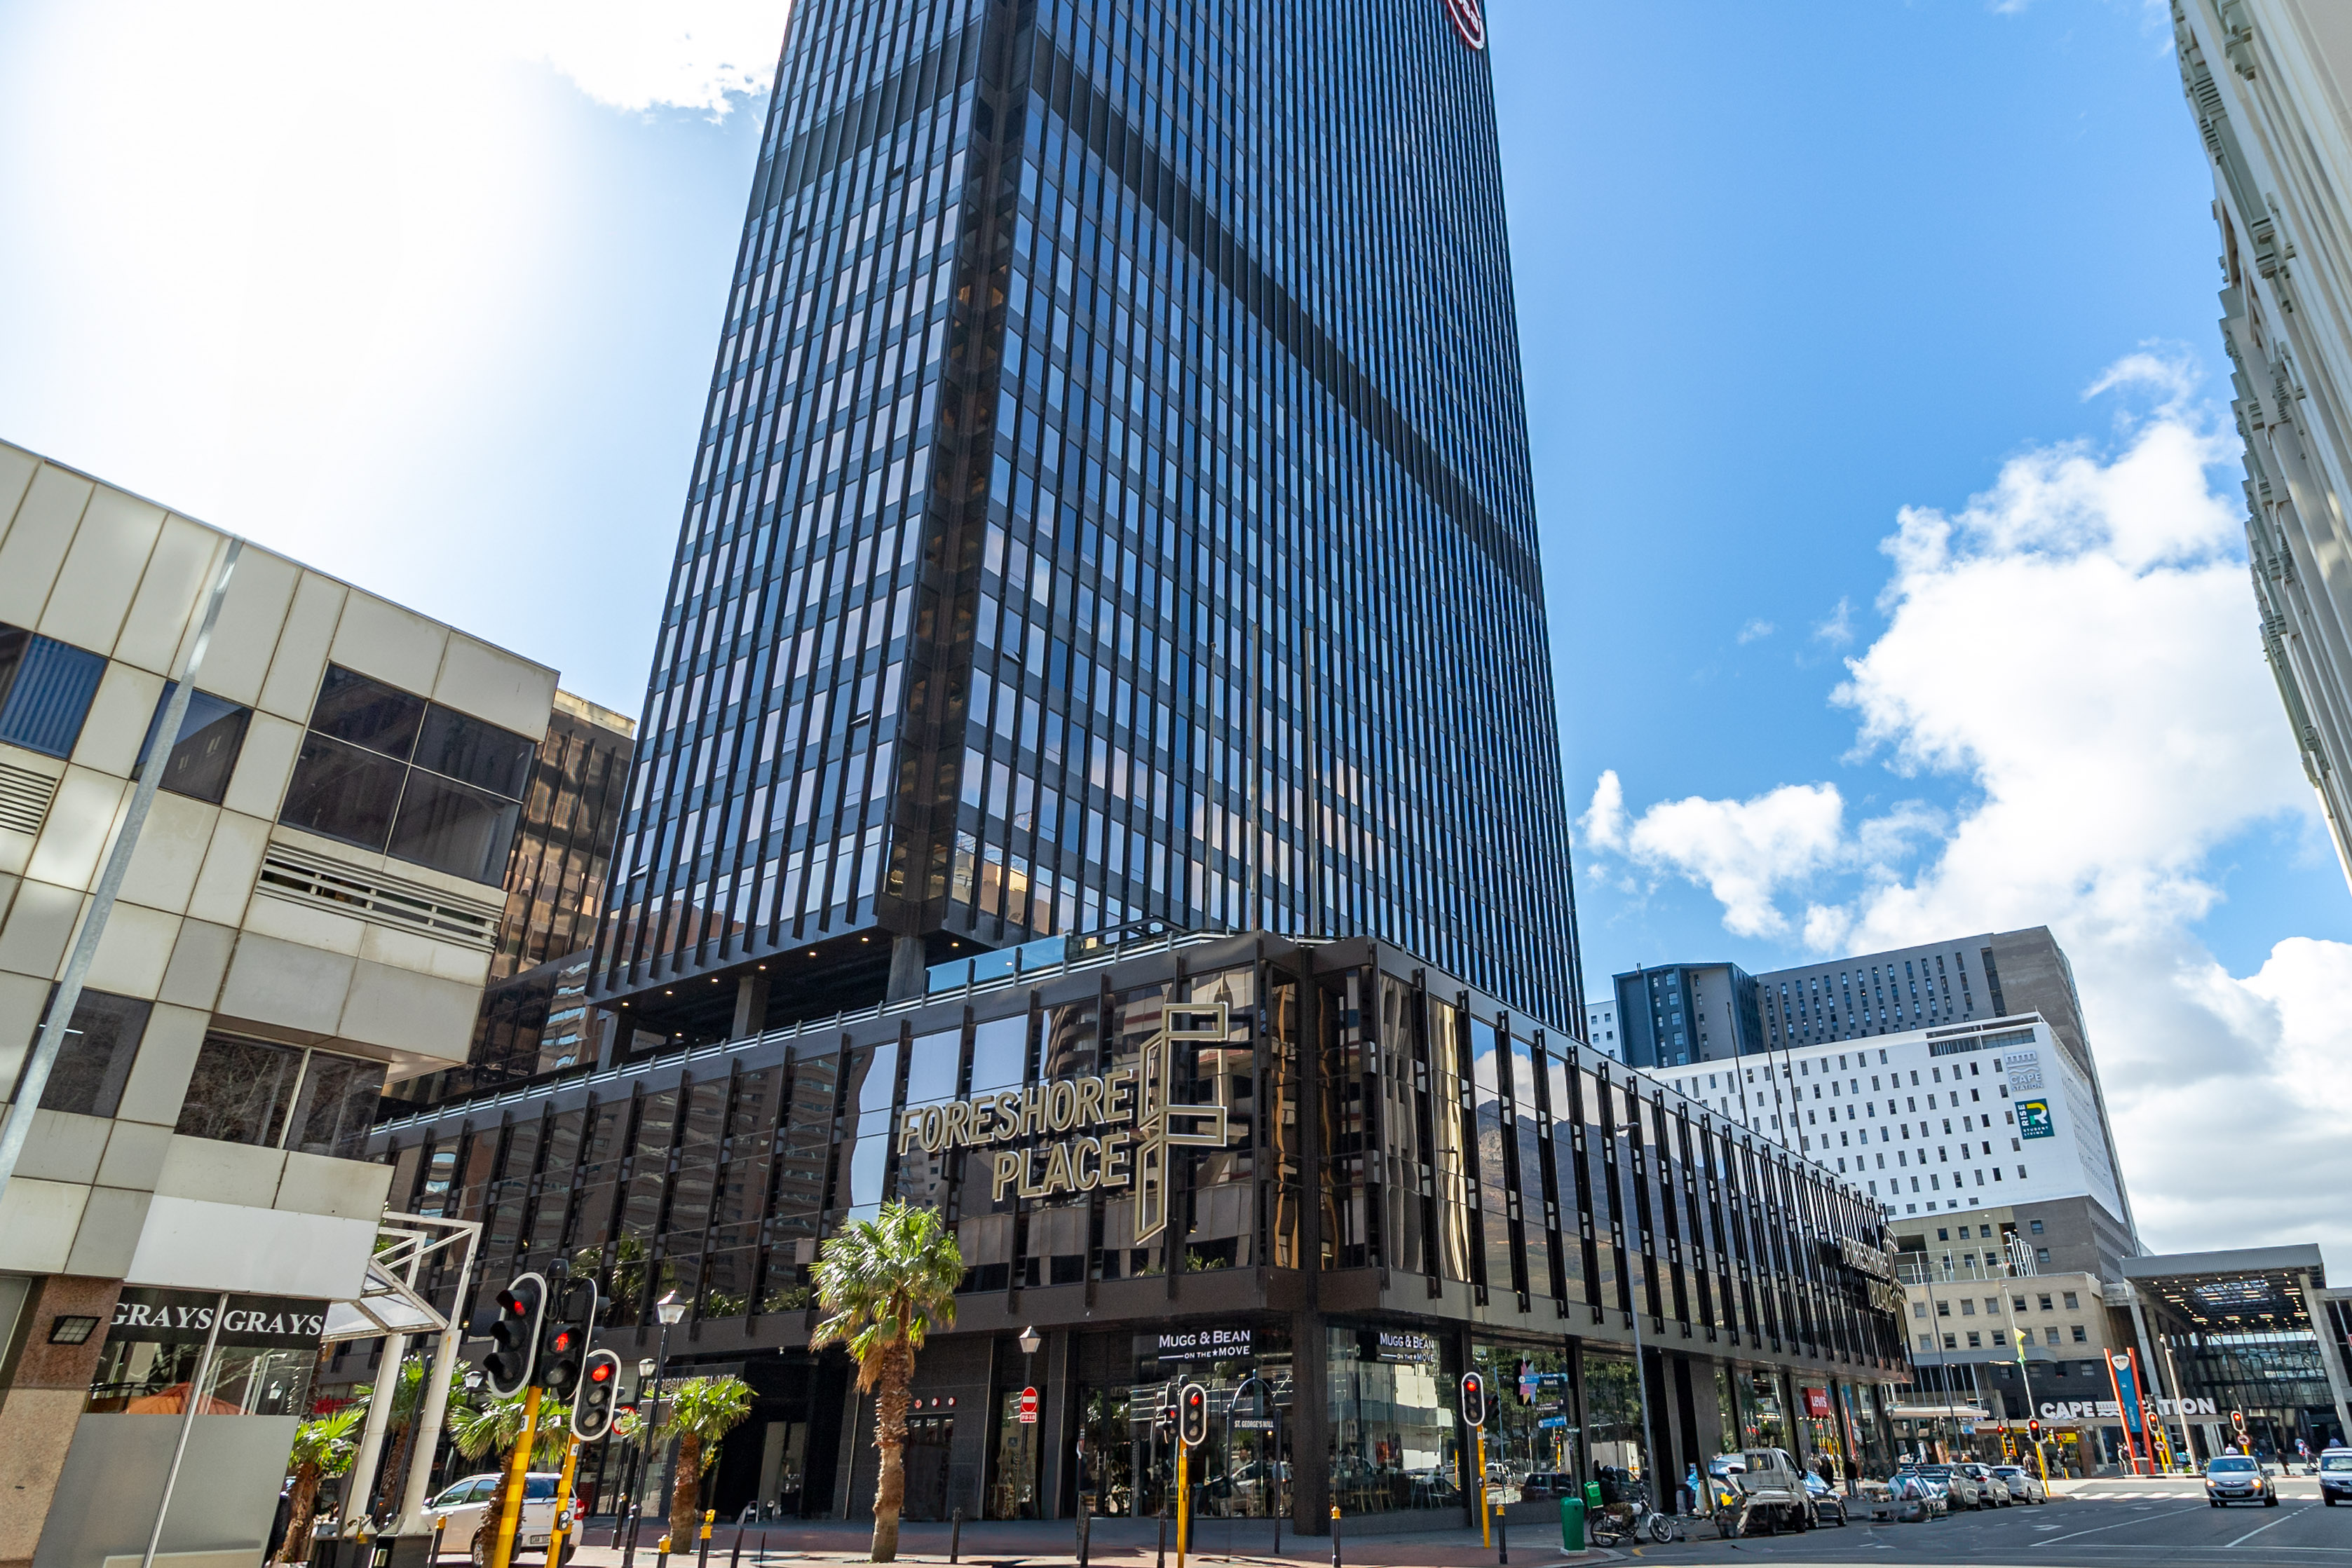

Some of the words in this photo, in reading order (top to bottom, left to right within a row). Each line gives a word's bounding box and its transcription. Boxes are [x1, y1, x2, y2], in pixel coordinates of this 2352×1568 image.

[2010, 1072, 2041, 1084] CAPE
[2011, 1083, 2044, 1091] STATION
[897, 1069, 1134, 1156] FORESHORE
[2018, 1104, 2029, 1126] RISE
[992, 1132, 1129, 1201] PLACE
[1840, 1234, 1890, 1280] FORESHORE
[111, 1303, 215, 1330] GRAYS
[223, 1310, 323, 1335] GRAYS
[1159, 1335, 1196, 1348] MUGG
[1199, 1332, 1210, 1344] &
[1213, 1330, 1250, 1344] BEAN
[1380, 1332, 1403, 1347] MUGG
[1405, 1335, 1412, 1347] &
[1413, 1336, 1434, 1349] BEAN
[1218, 1345, 1250, 1356] MOVE
[1417, 1354, 1434, 1362] MOVE
[2040, 1401, 2095, 1419] CAPE
